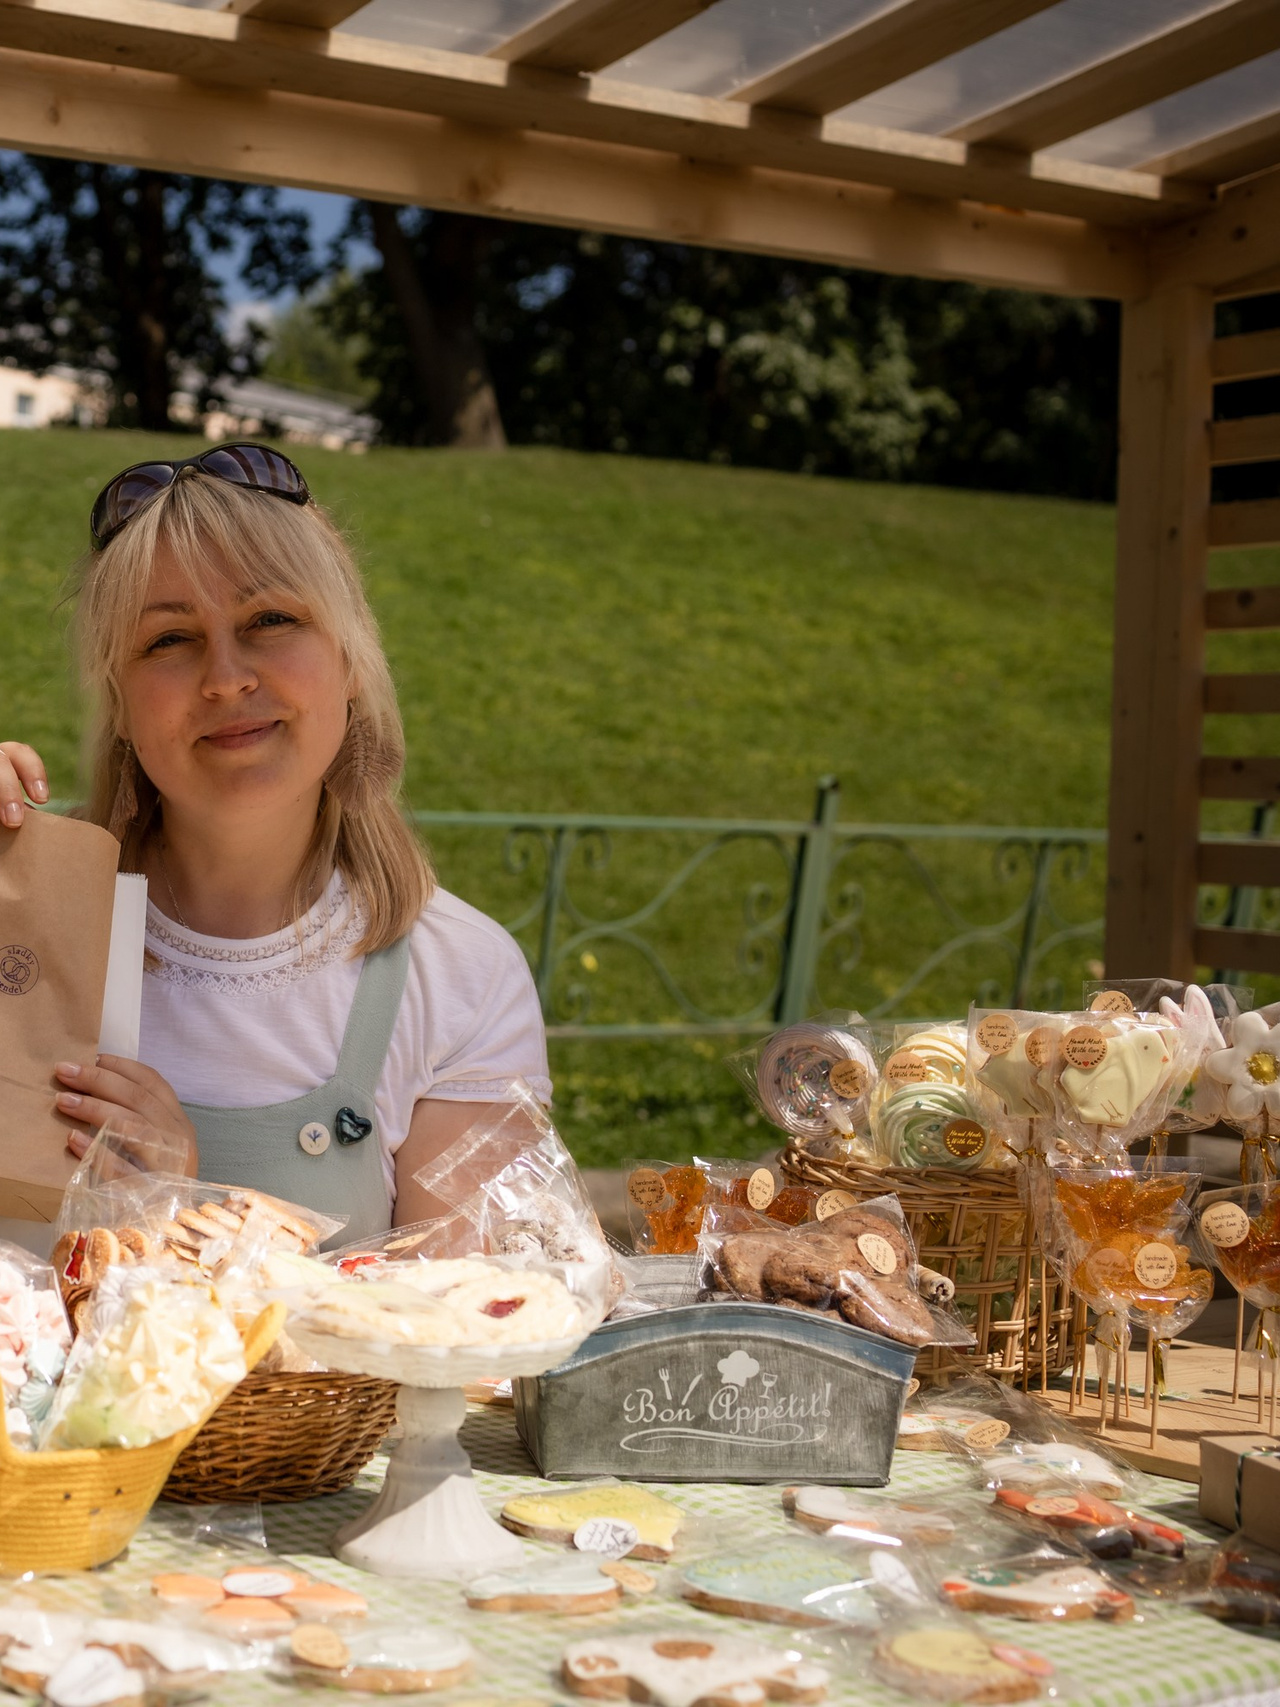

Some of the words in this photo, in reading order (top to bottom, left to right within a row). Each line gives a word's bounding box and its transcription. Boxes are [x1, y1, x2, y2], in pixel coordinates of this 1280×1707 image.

[7, 946, 35, 966] sladky
[1068, 1037, 1087, 1045] Hand
[1086, 1037, 1104, 1045] Made
[1070, 1046, 1087, 1054] With
[893, 1070, 909, 1078] With
[949, 1129, 967, 1137] Hand
[965, 1130, 983, 1138] Made
[950, 1137, 967, 1145] With
[623, 1387, 696, 1424] Bon
[708, 1382, 832, 1434] Appétit!
